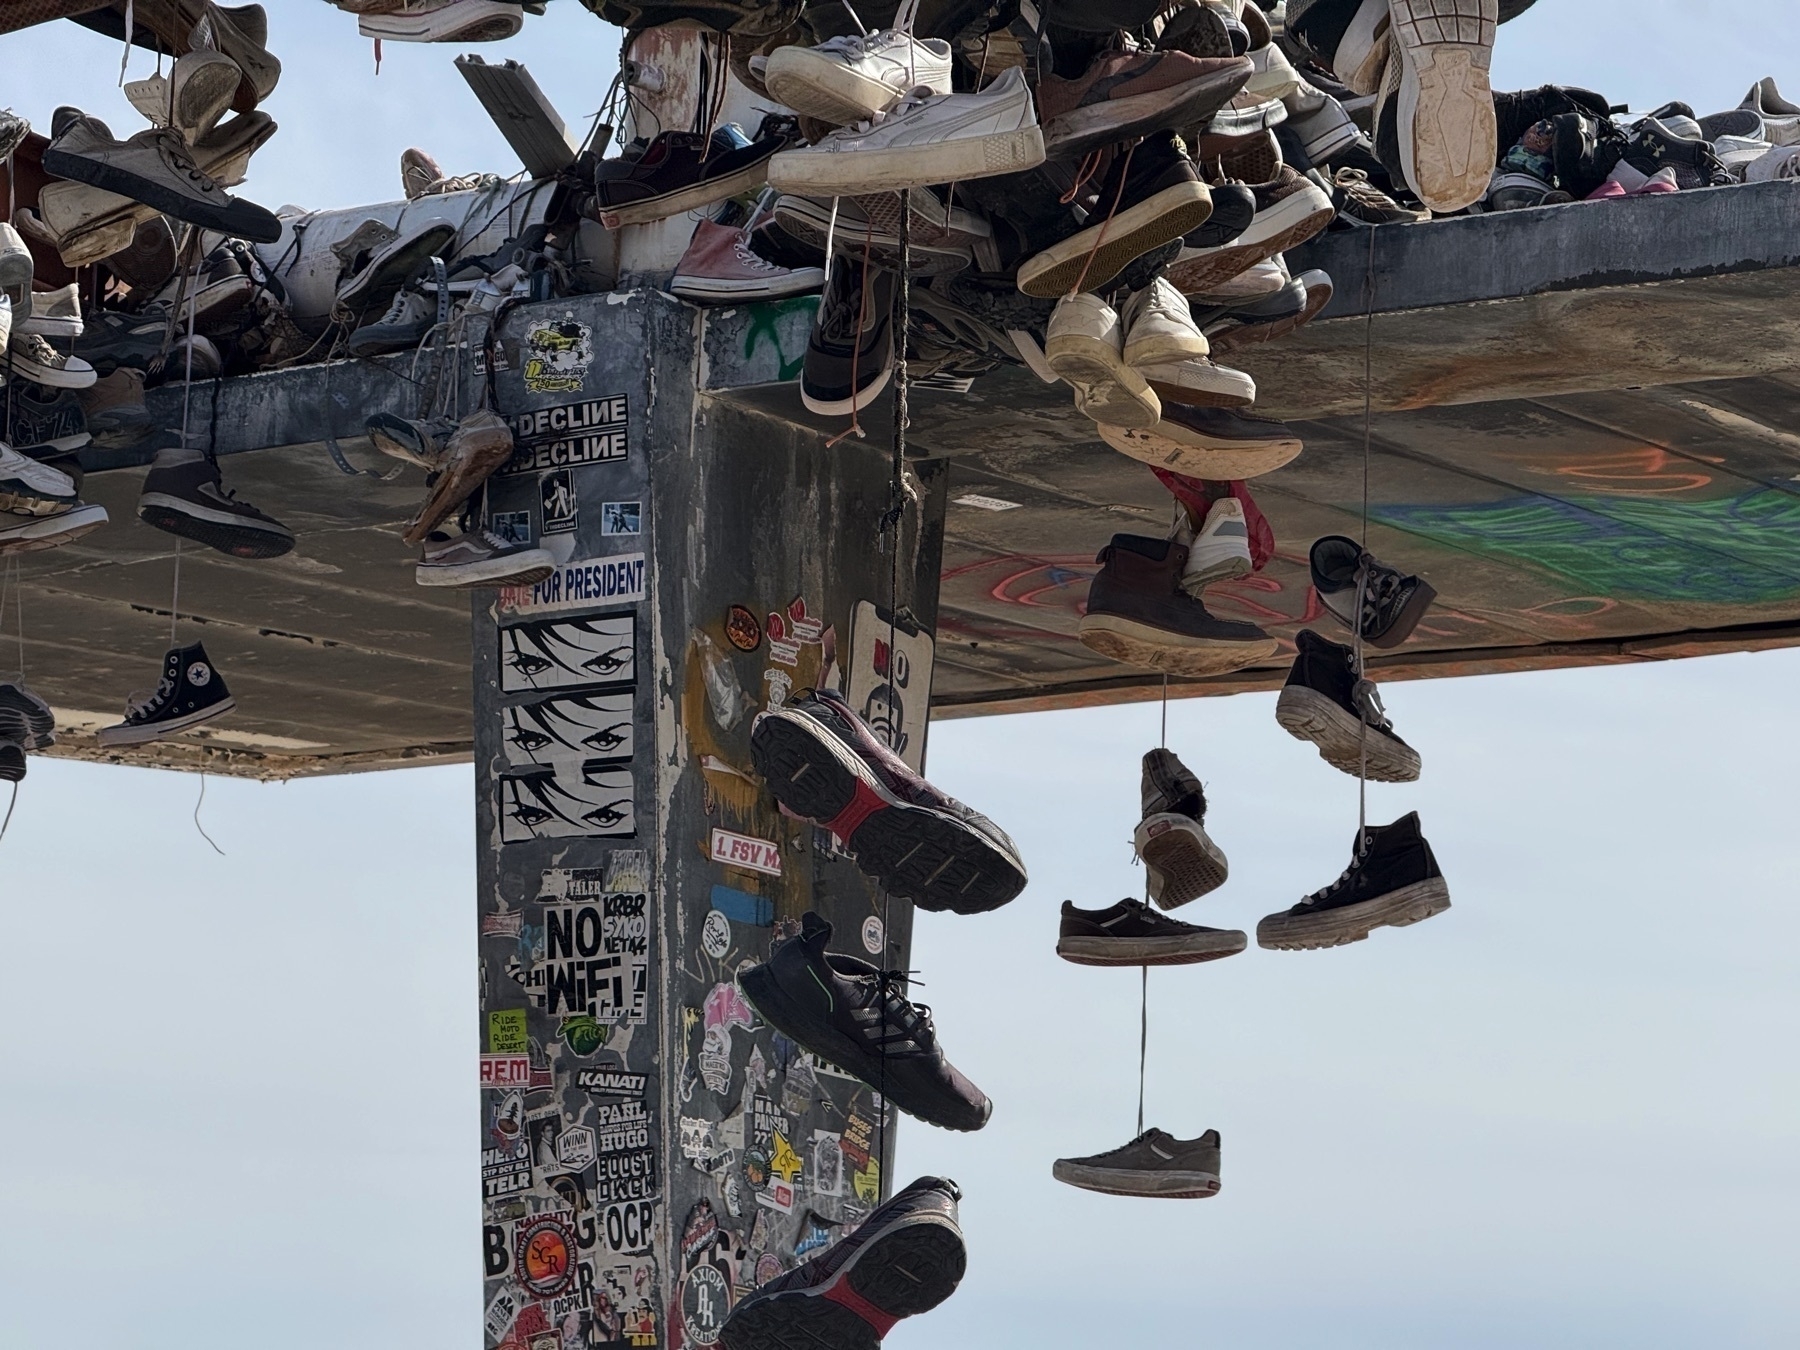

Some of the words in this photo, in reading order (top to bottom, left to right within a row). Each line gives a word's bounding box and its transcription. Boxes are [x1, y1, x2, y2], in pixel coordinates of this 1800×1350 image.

[533, 570, 561, 604] FOR
[565, 559, 643, 601] PRESIDENT
[730, 840, 762, 864] FSV
[546, 906, 602, 958] NO
[603, 915, 646, 938] SYKO
[492, 1013, 517, 1025] RIDE
[500, 1025, 520, 1034] MOTO
[494, 1033, 518, 1043] RIDE
[497, 1041, 526, 1051] DESERT
[578, 1071, 646, 1090] KANATI
[847, 1114, 873, 1134] BUSES
[563, 1131, 588, 1149] WINN
[600, 1129, 648, 1152] HUGO
[844, 1128, 871, 1151] BRIDGE
[482, 1142, 529, 1166] HEO
[596, 1150, 654, 1181] BOOST
[482, 1167, 498, 1178] STP
[486, 1171, 530, 1196] TELR
[606, 1201, 653, 1251] OCP
[691, 1267, 724, 1293] AXIOM
[554, 1294, 582, 1315] OCPK
